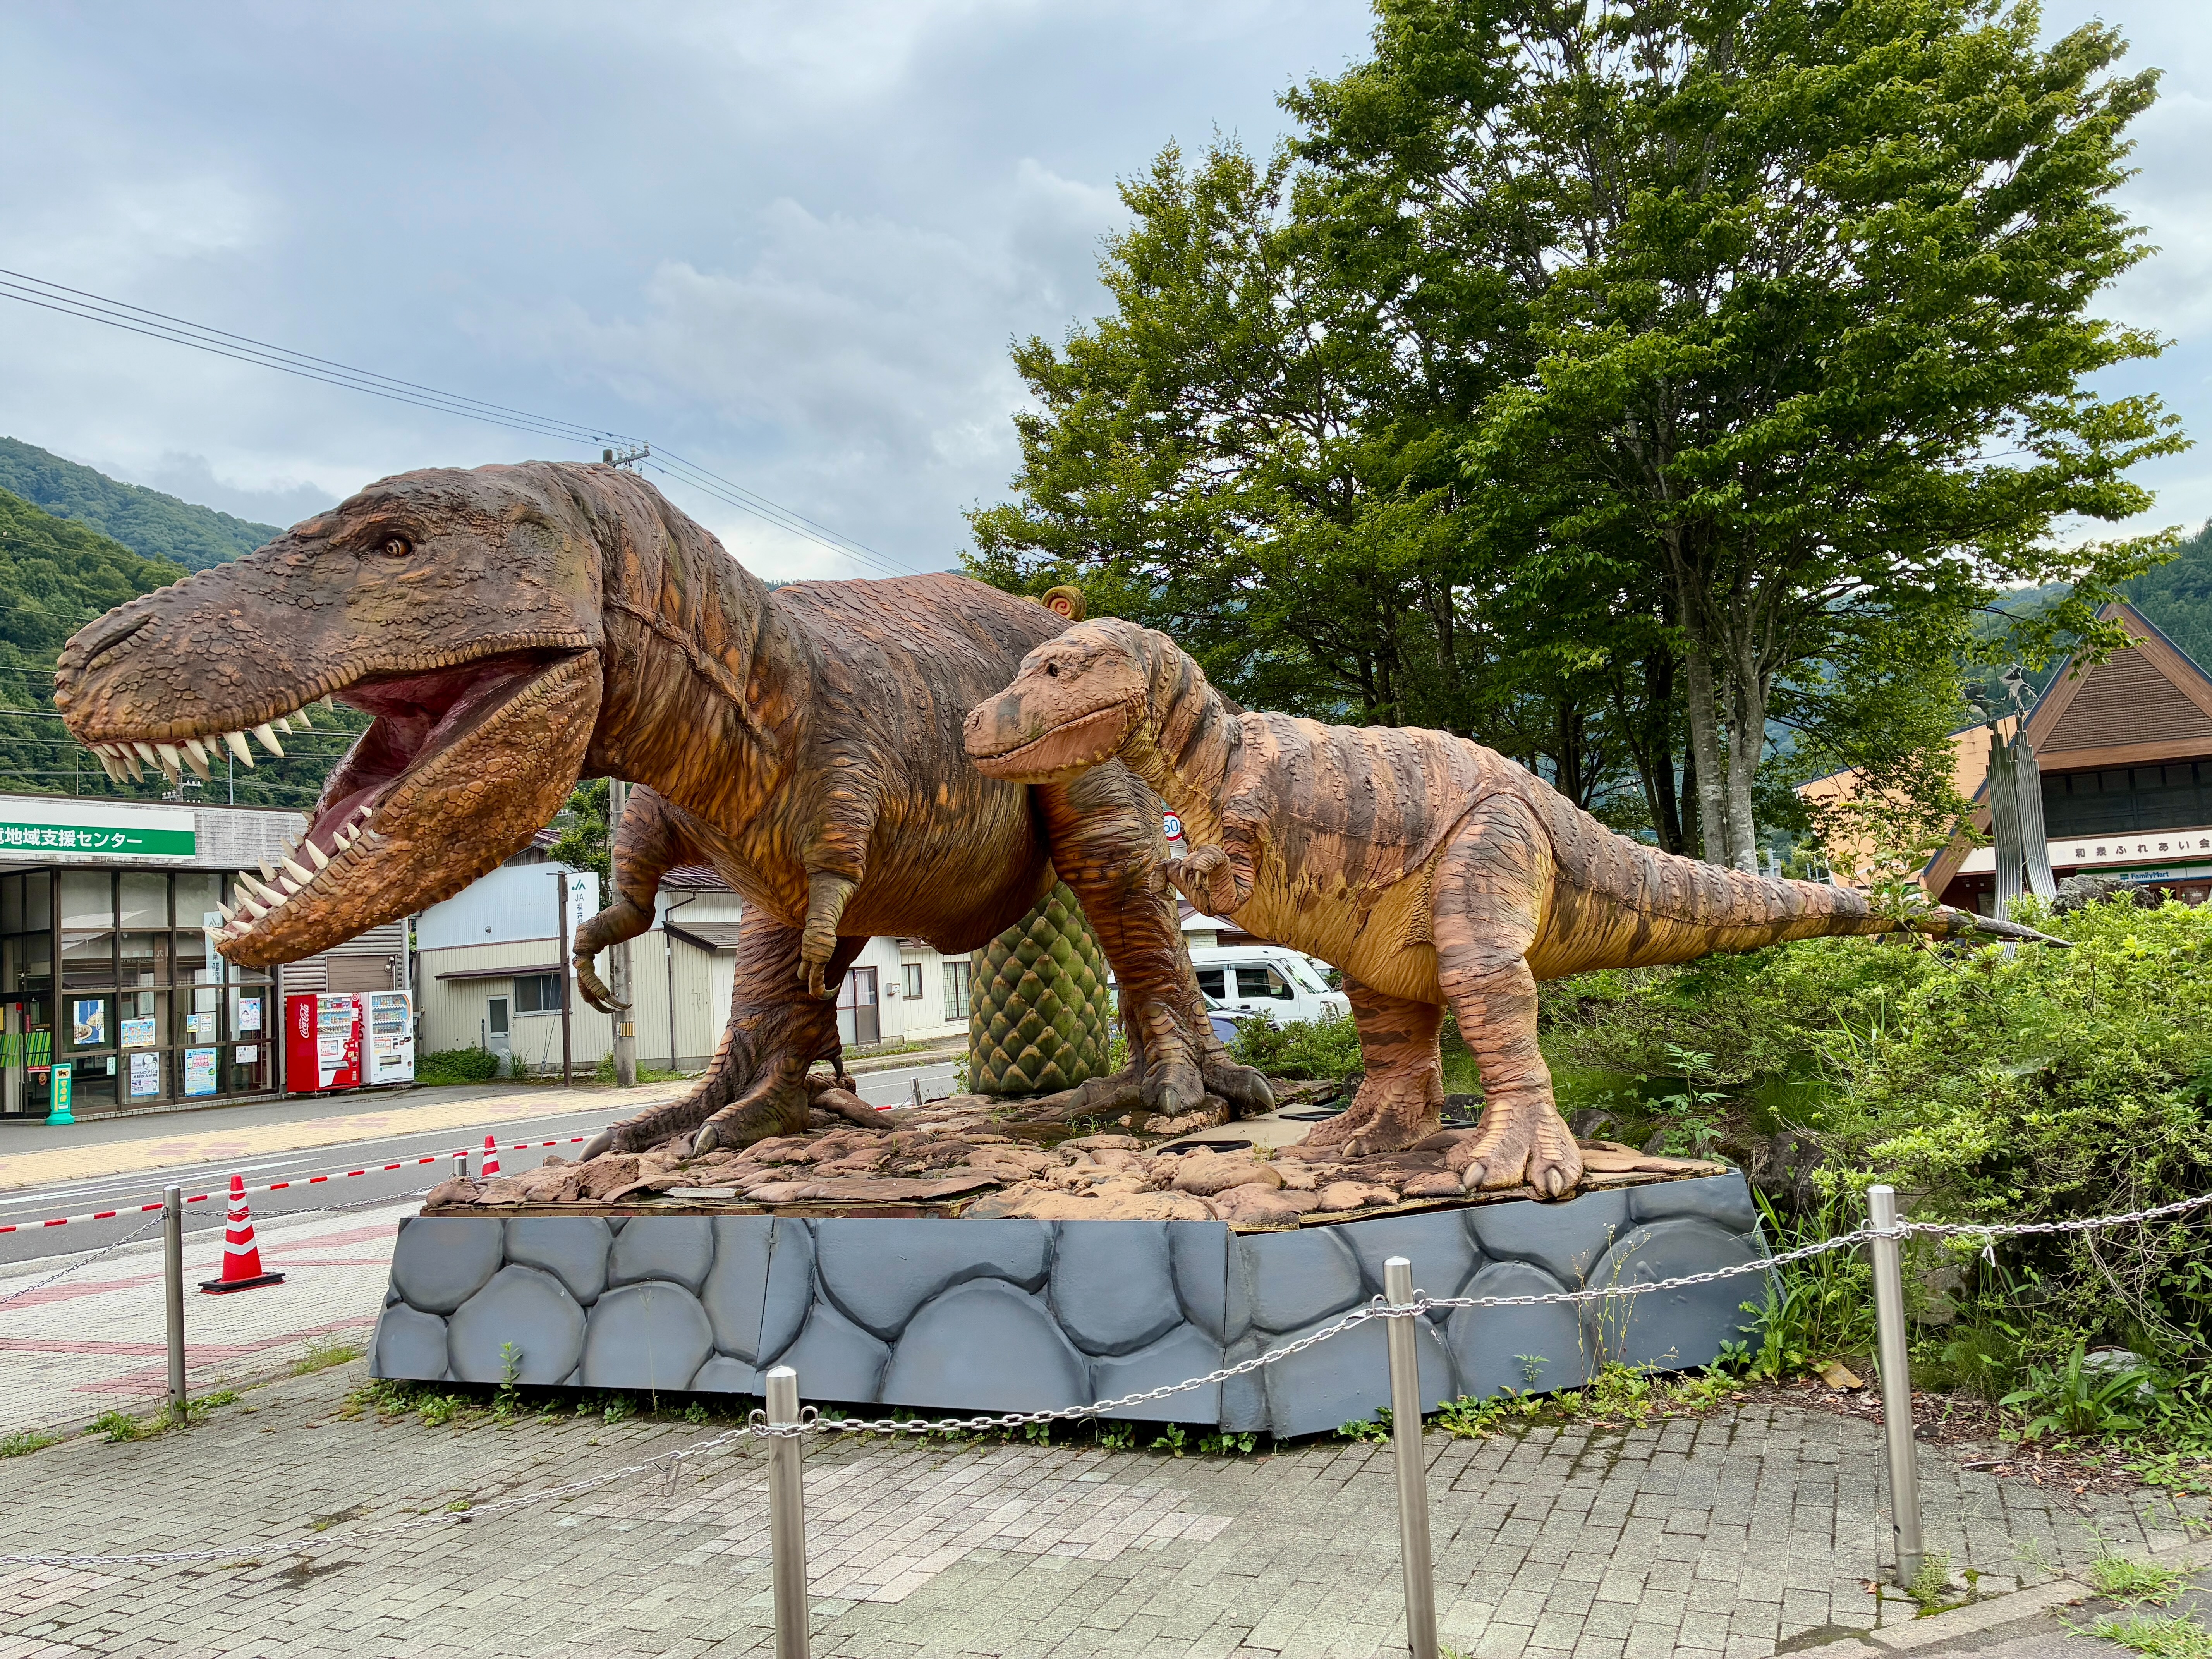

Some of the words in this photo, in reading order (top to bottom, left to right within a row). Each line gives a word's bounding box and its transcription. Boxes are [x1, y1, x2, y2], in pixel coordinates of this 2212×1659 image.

[1163, 819, 1178, 833] 50
[0, 827, 143, 848] 地域支援センター
